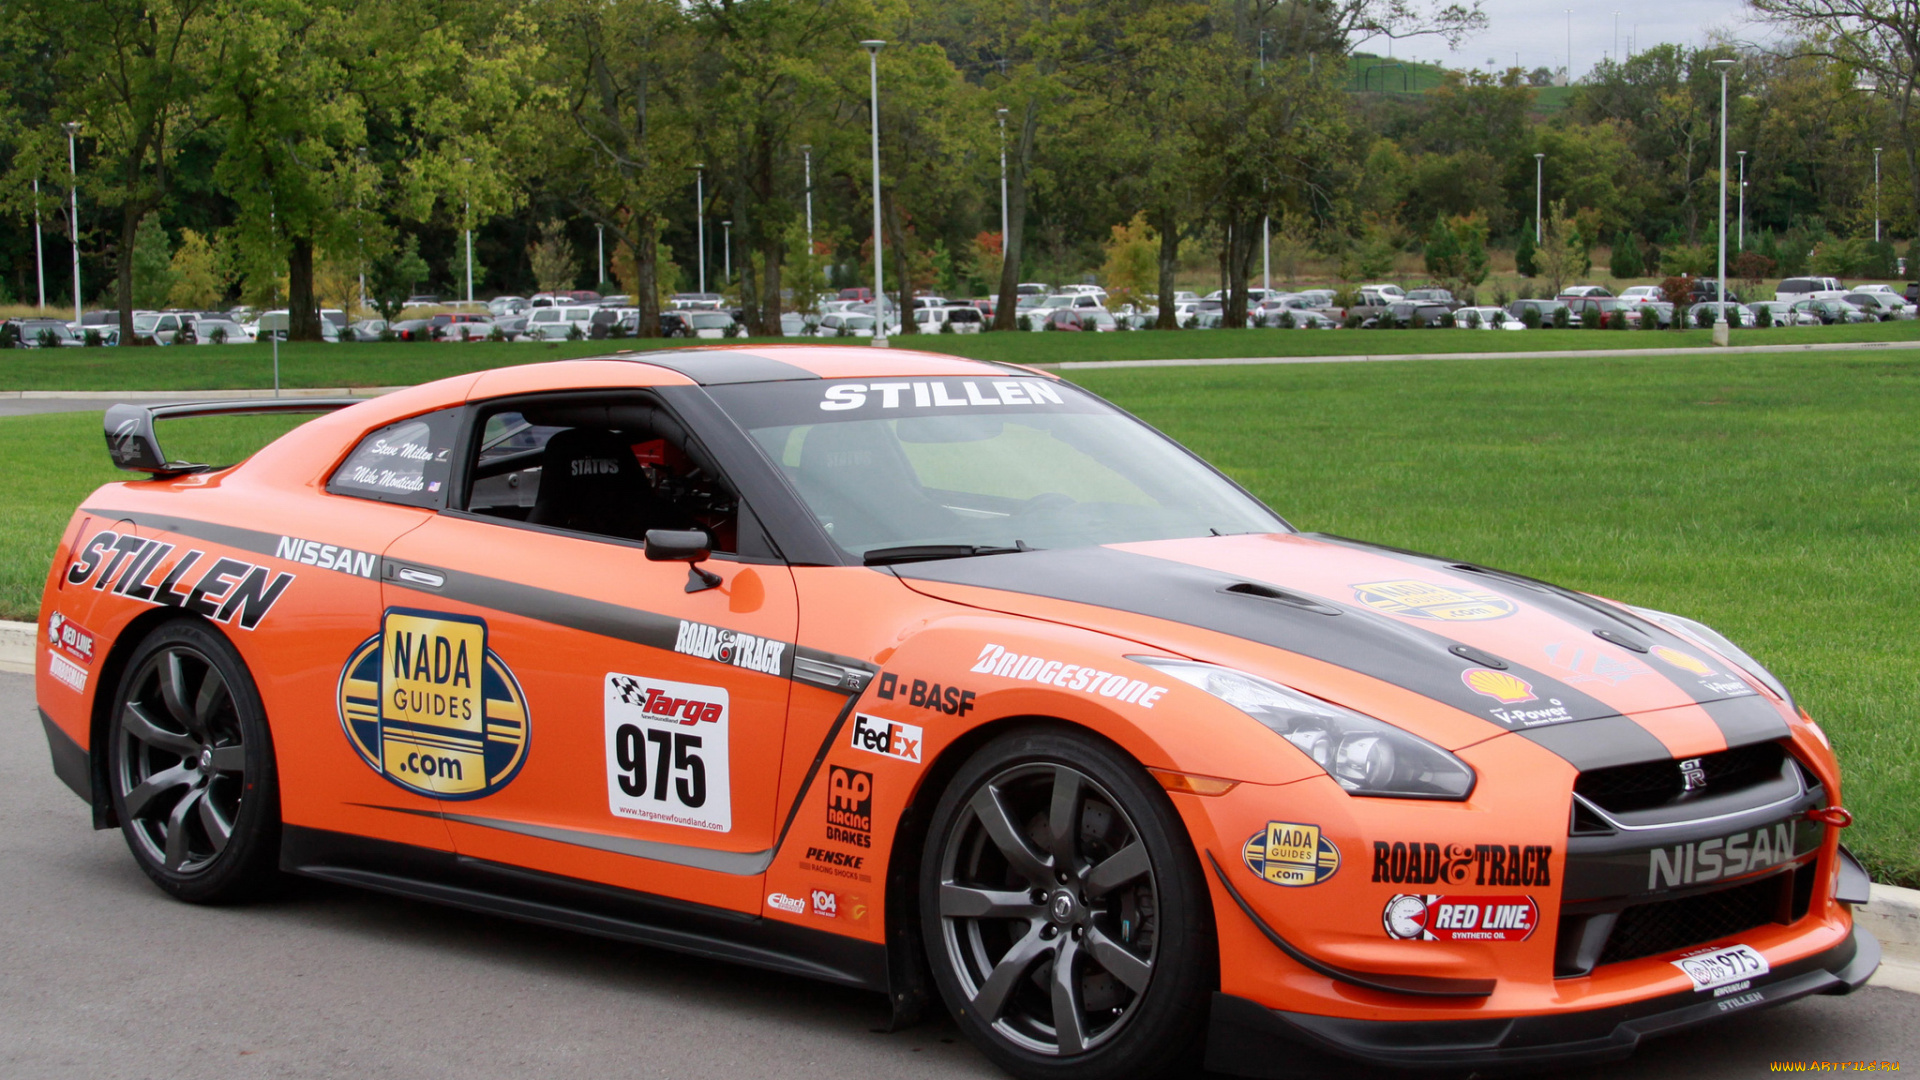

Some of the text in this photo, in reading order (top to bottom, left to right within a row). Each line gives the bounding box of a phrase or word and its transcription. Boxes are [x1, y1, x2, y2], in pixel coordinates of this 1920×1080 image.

[819, 380, 1064, 411] STILLEN
[371, 439, 434, 461] Steve Millen
[353, 465, 424, 491] Mike Monticello
[276, 535, 376, 578] NISSAN
[67, 530, 296, 631] STILLEN
[62, 623, 77, 647] RED
[394, 630, 472, 688] NADA
[969, 643, 1169, 708] BRIDGESTONE
[393, 688, 472, 720] GUIDES
[642, 688, 723, 726] Targa
[909, 679, 976, 717] BASF
[1494, 706, 1568, 723] V-Power
[852, 715, 919, 761] FedEx
[400, 752, 463, 781] .com
[616, 723, 706, 808] 975
[829, 768, 871, 812] AP
[619, 806, 724, 831] www.targanewfoundland.com
[829, 808, 870, 831] RACING
[827, 826, 871, 849] BRAKES
[1272, 829, 1312, 849] NADA
[806, 847, 864, 869] PENSKE
[1271, 848, 1312, 860] GUIDES
[1648, 820, 1796, 890] NISSAN
[812, 864, 858, 880] RACING SHOCKS
[1272, 870, 1304, 881] .com
[811, 890, 837, 912] 104
[1436, 904, 1529, 929] RED LINE
[1452, 932, 1506, 940] SYNTHETIC OIL
[1700, 957, 1717, 967] TN
[1710, 965, 1726, 978] 09
[1716, 949, 1760, 975] 975
[1717, 991, 1764, 1011] STILLEN
